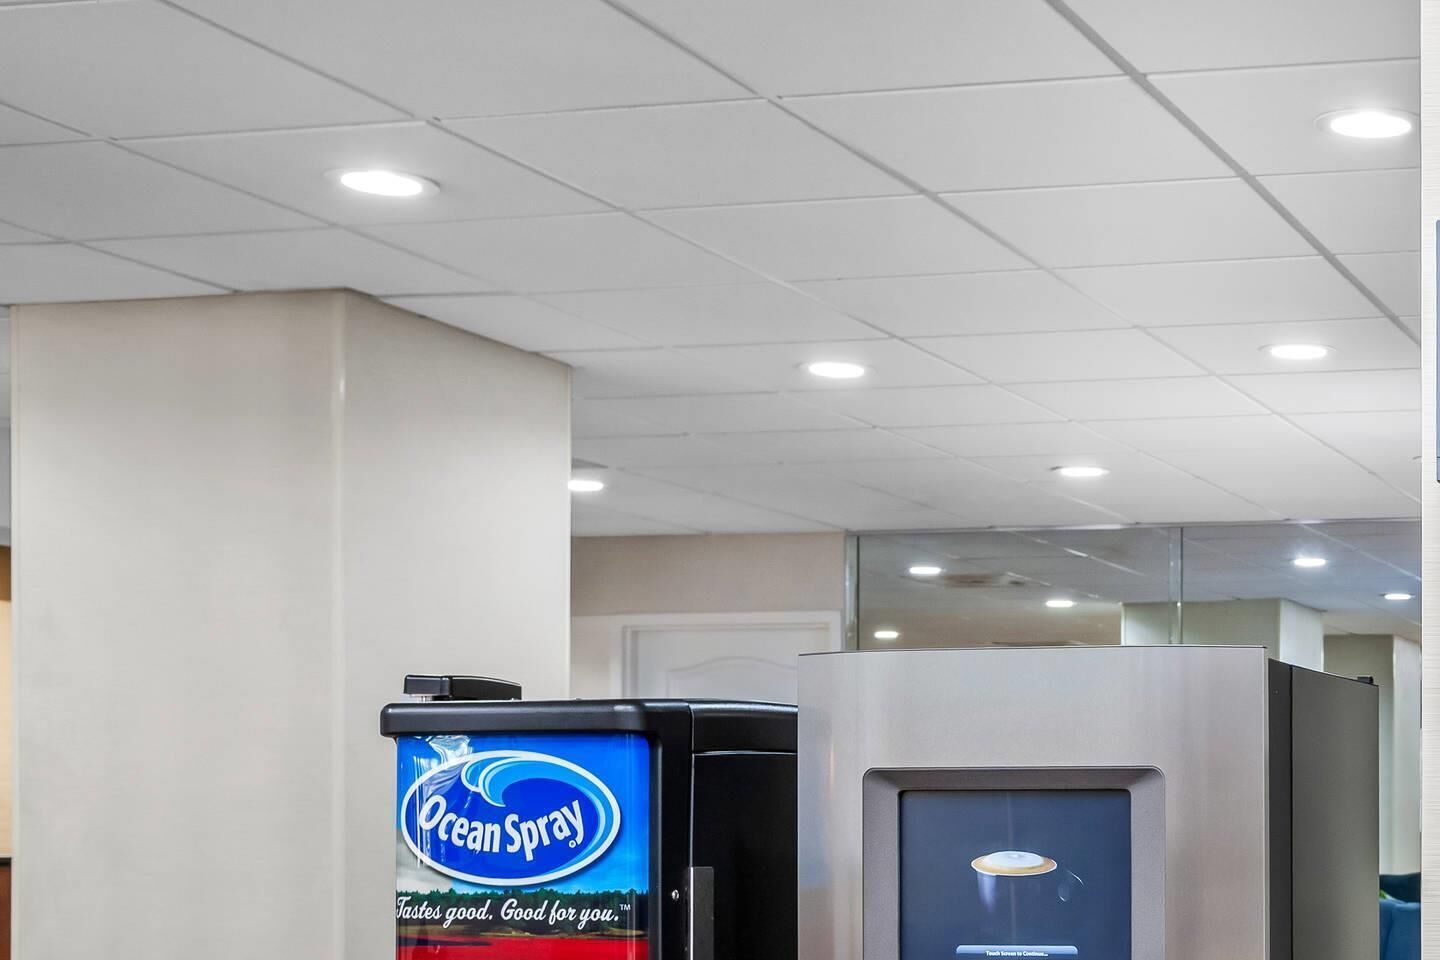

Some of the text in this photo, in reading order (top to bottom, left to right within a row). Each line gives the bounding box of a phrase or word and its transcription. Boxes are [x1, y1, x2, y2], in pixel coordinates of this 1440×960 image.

[419, 794, 584, 862] Ocean Spray
[396, 896, 442, 921] Tastes
[444, 898, 494, 928] good.
[500, 898, 547, 922] Good
[548, 900, 576, 926] for
